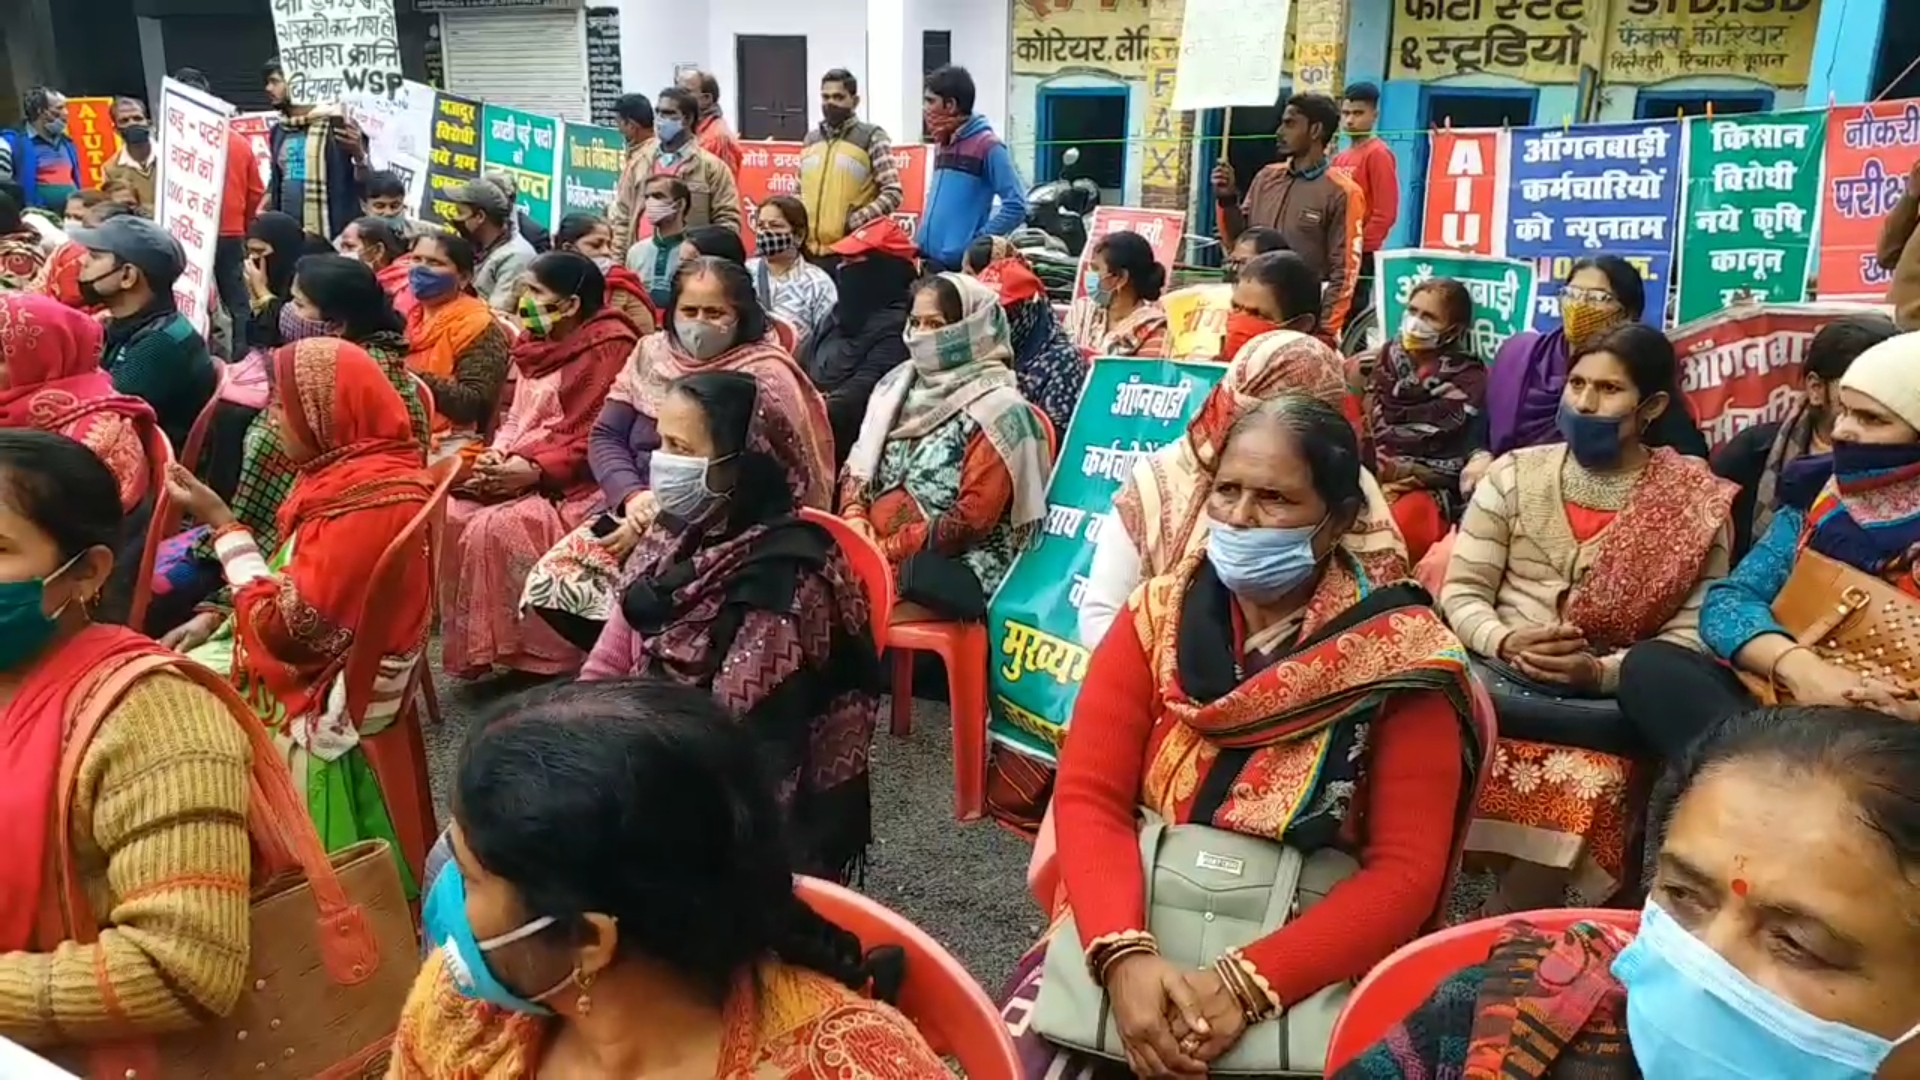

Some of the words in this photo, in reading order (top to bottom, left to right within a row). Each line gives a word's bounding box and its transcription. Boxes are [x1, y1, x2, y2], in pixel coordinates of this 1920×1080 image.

[342, 67, 404, 101] WSP
[1709, 121, 1810, 152] किसान
[1441, 139, 1484, 254] AIU
[1519, 167, 1669, 202] कर्मचारियों
[1512, 211, 1553, 242] को
[1694, 204, 1743, 233] नये
